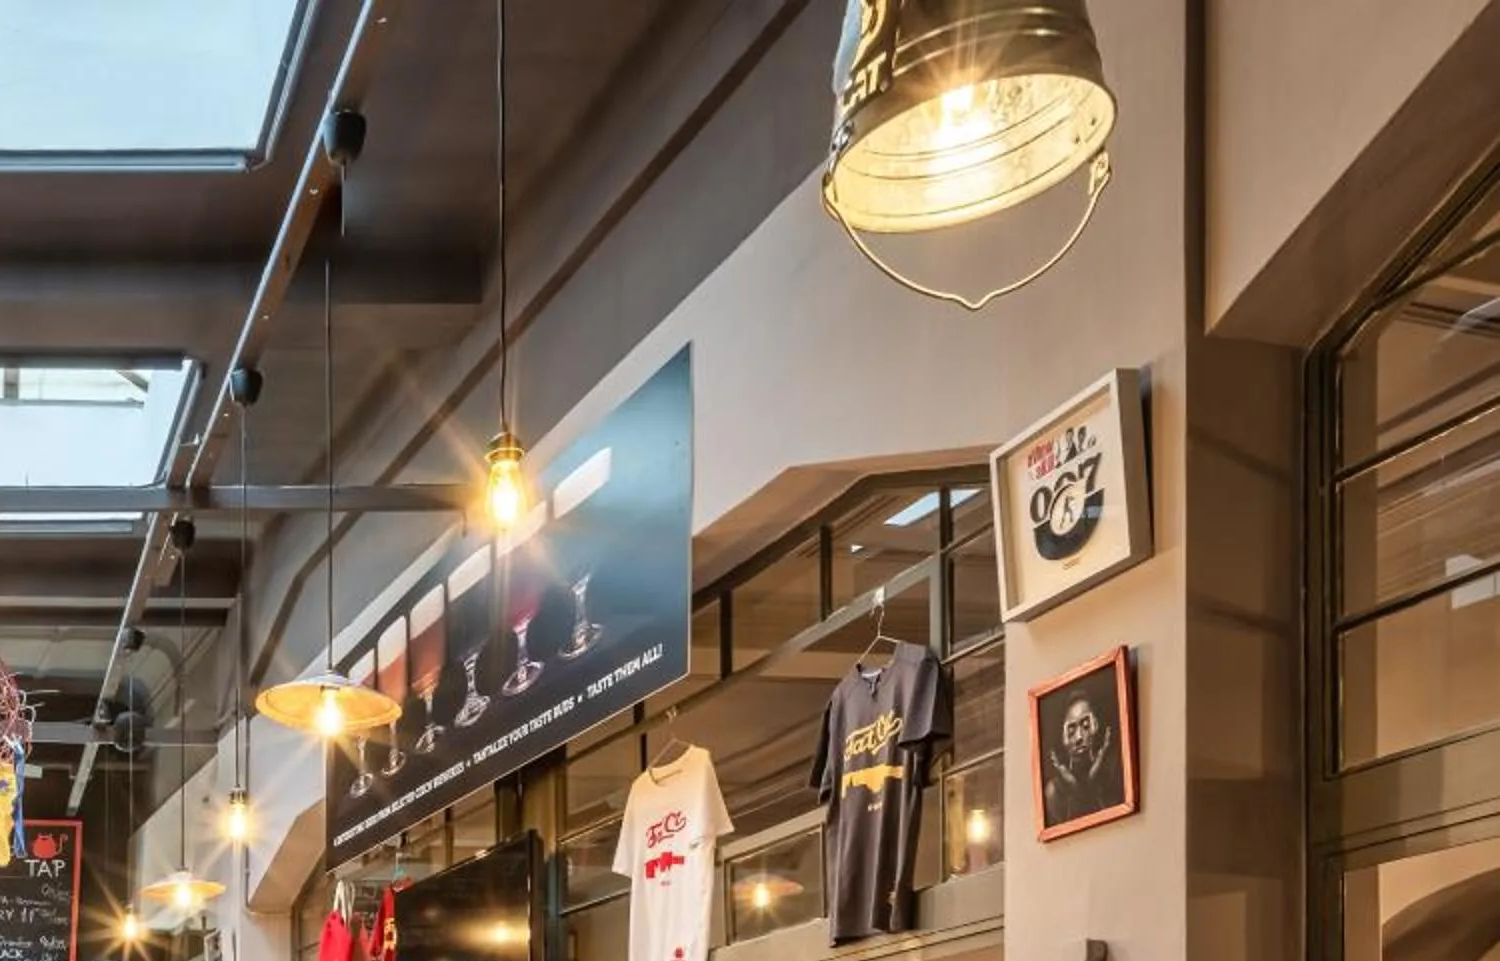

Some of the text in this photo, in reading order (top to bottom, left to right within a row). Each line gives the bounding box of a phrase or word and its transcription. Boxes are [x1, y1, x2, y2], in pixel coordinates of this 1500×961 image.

[587, 671, 614, 699] TASTE
[615, 656, 641, 682] THEM
[642, 643, 663, 667] ALL!
[24, 859, 66, 878] TAP
